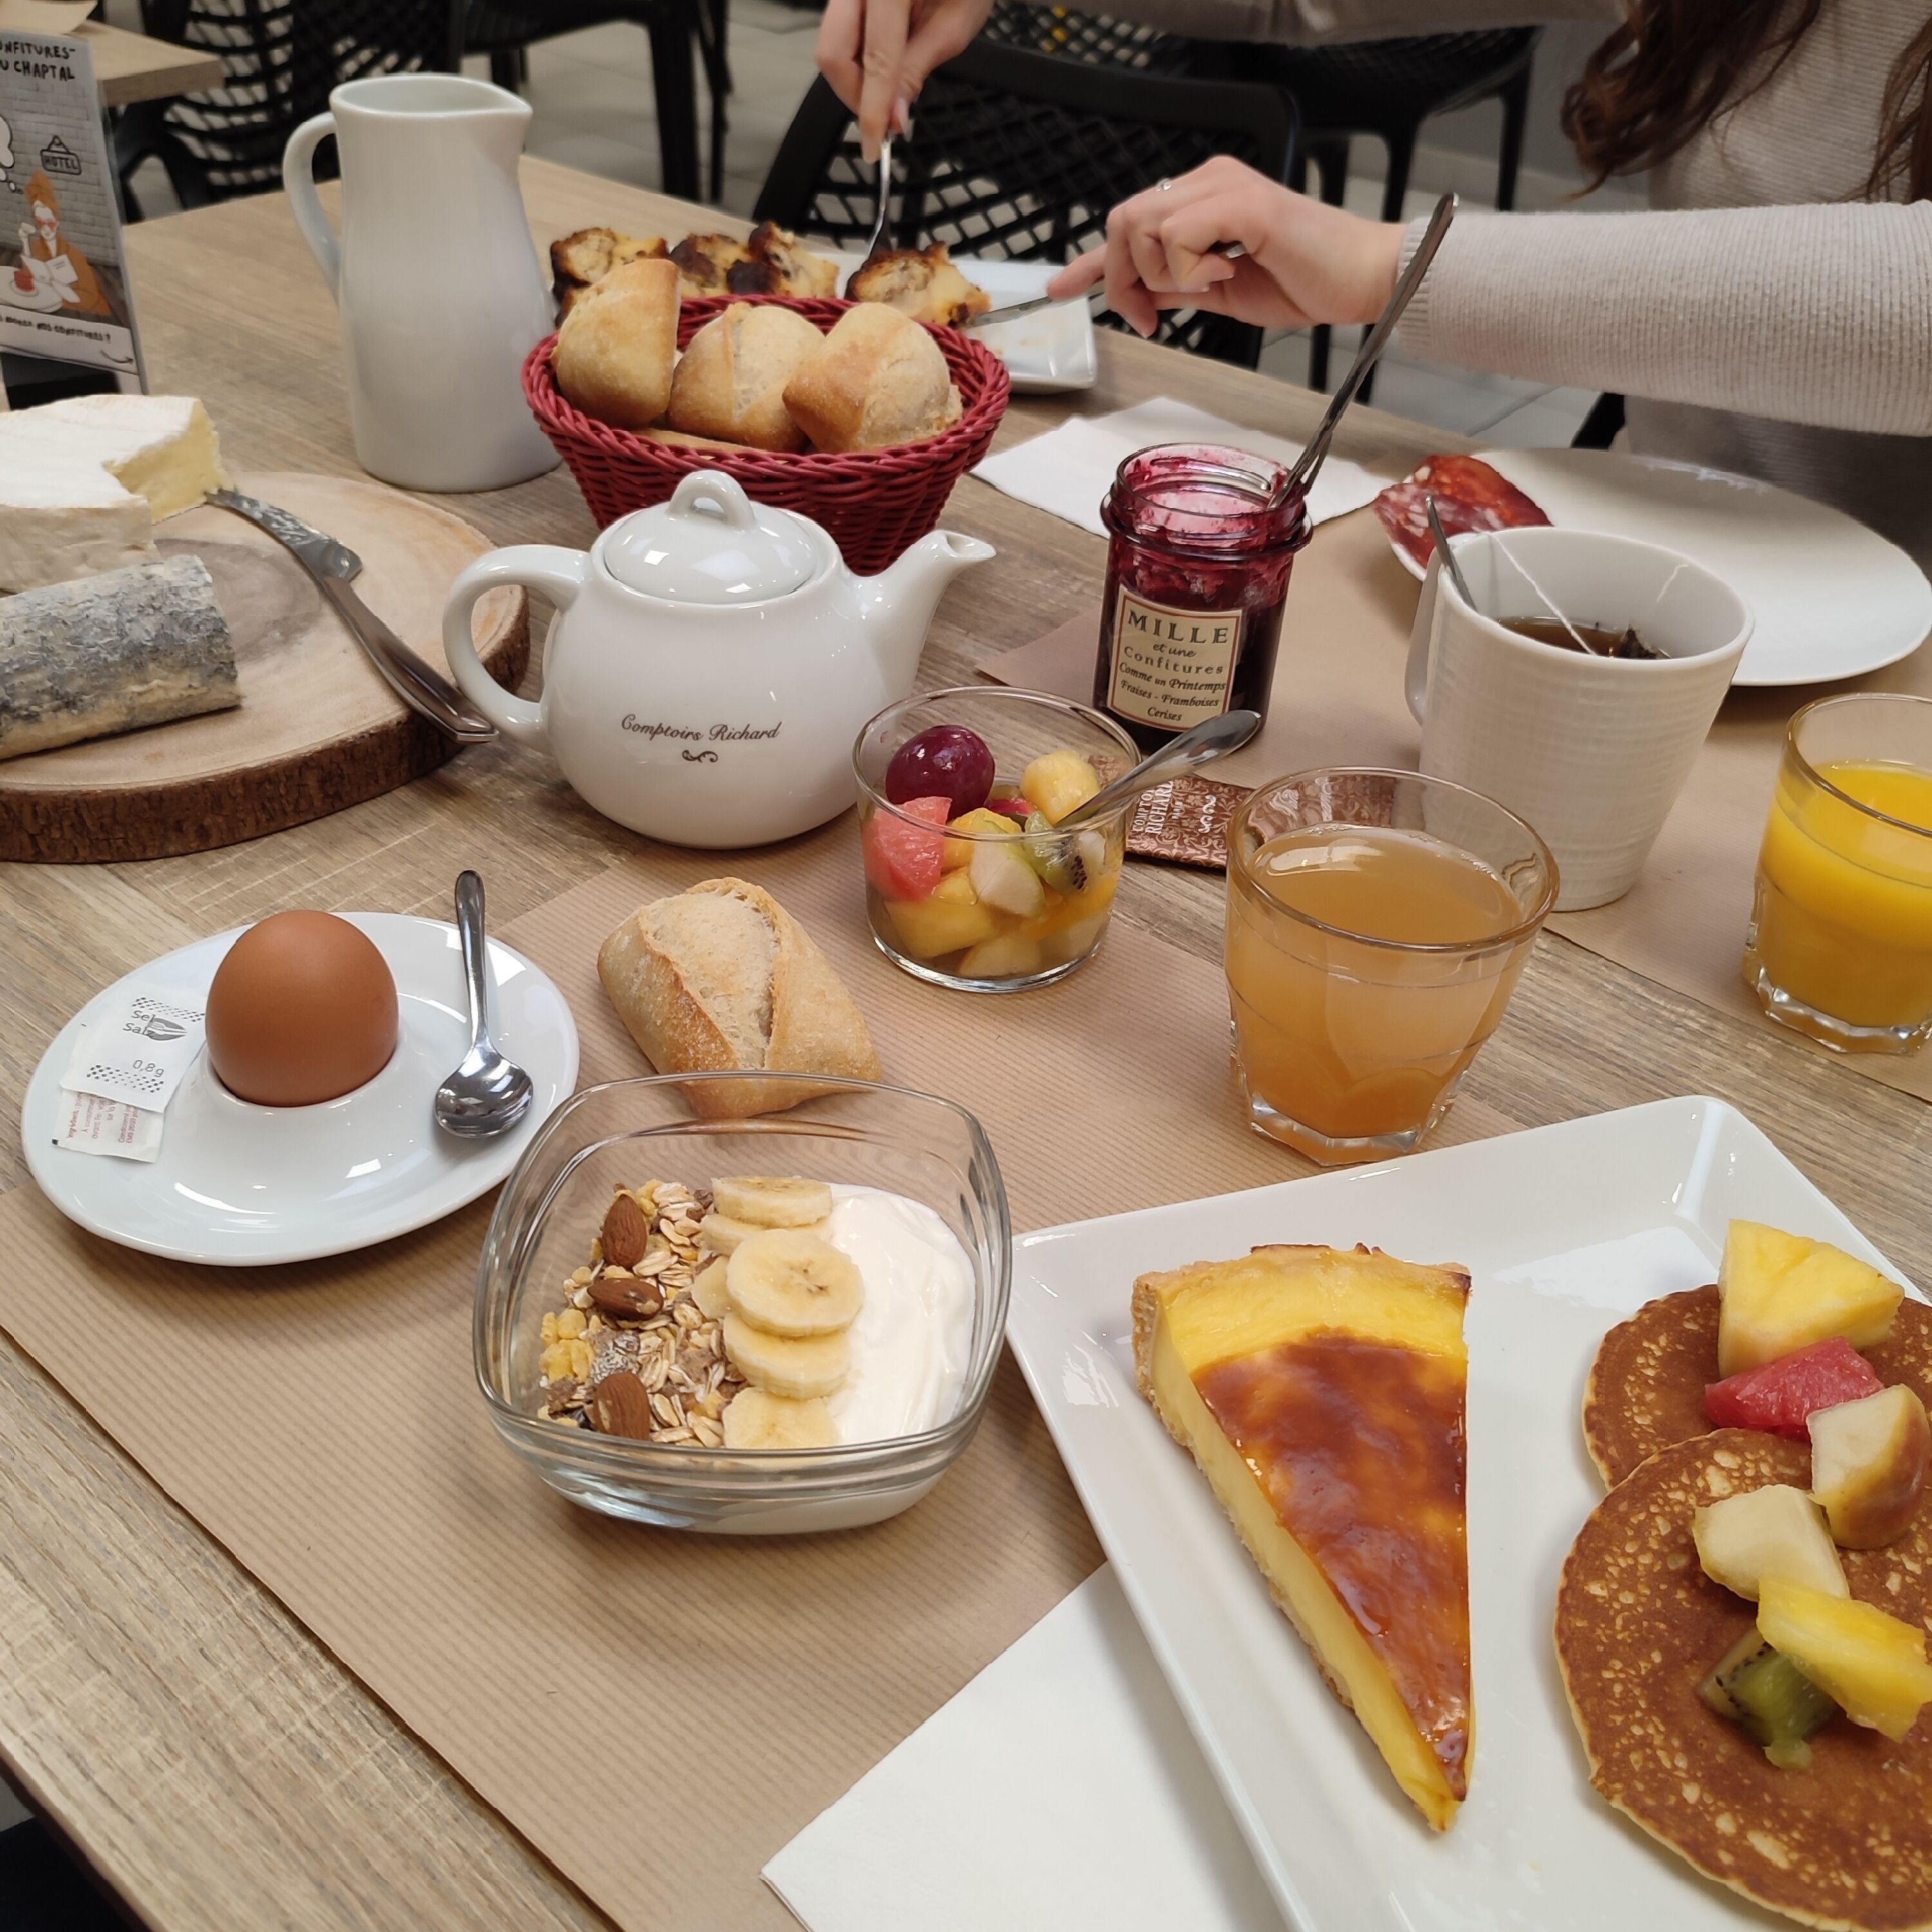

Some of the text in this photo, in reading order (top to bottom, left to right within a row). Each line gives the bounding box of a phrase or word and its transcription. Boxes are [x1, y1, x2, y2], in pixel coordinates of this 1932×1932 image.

[14, 61, 75, 82] CHAPTAL
[1128, 610, 1228, 643] MILLE
[1124, 646, 1223, 674] Confitures
[1153, 643, 1197, 658] et une
[1119, 662, 1226, 693] Comme un Printemps
[1121, 679, 1151, 699] Fraises
[1161, 694, 1219, 706] Framboises
[1148, 706, 1182, 721] Cerises
[621, 714, 782, 741] Comptoirs Richard
[1132, 790, 1155, 833] COMPTOI
[1171, 801, 1183, 820] PARIS
[131, 1010, 155, 1023] Sel
[122, 1023, 155, 1038] Salz
